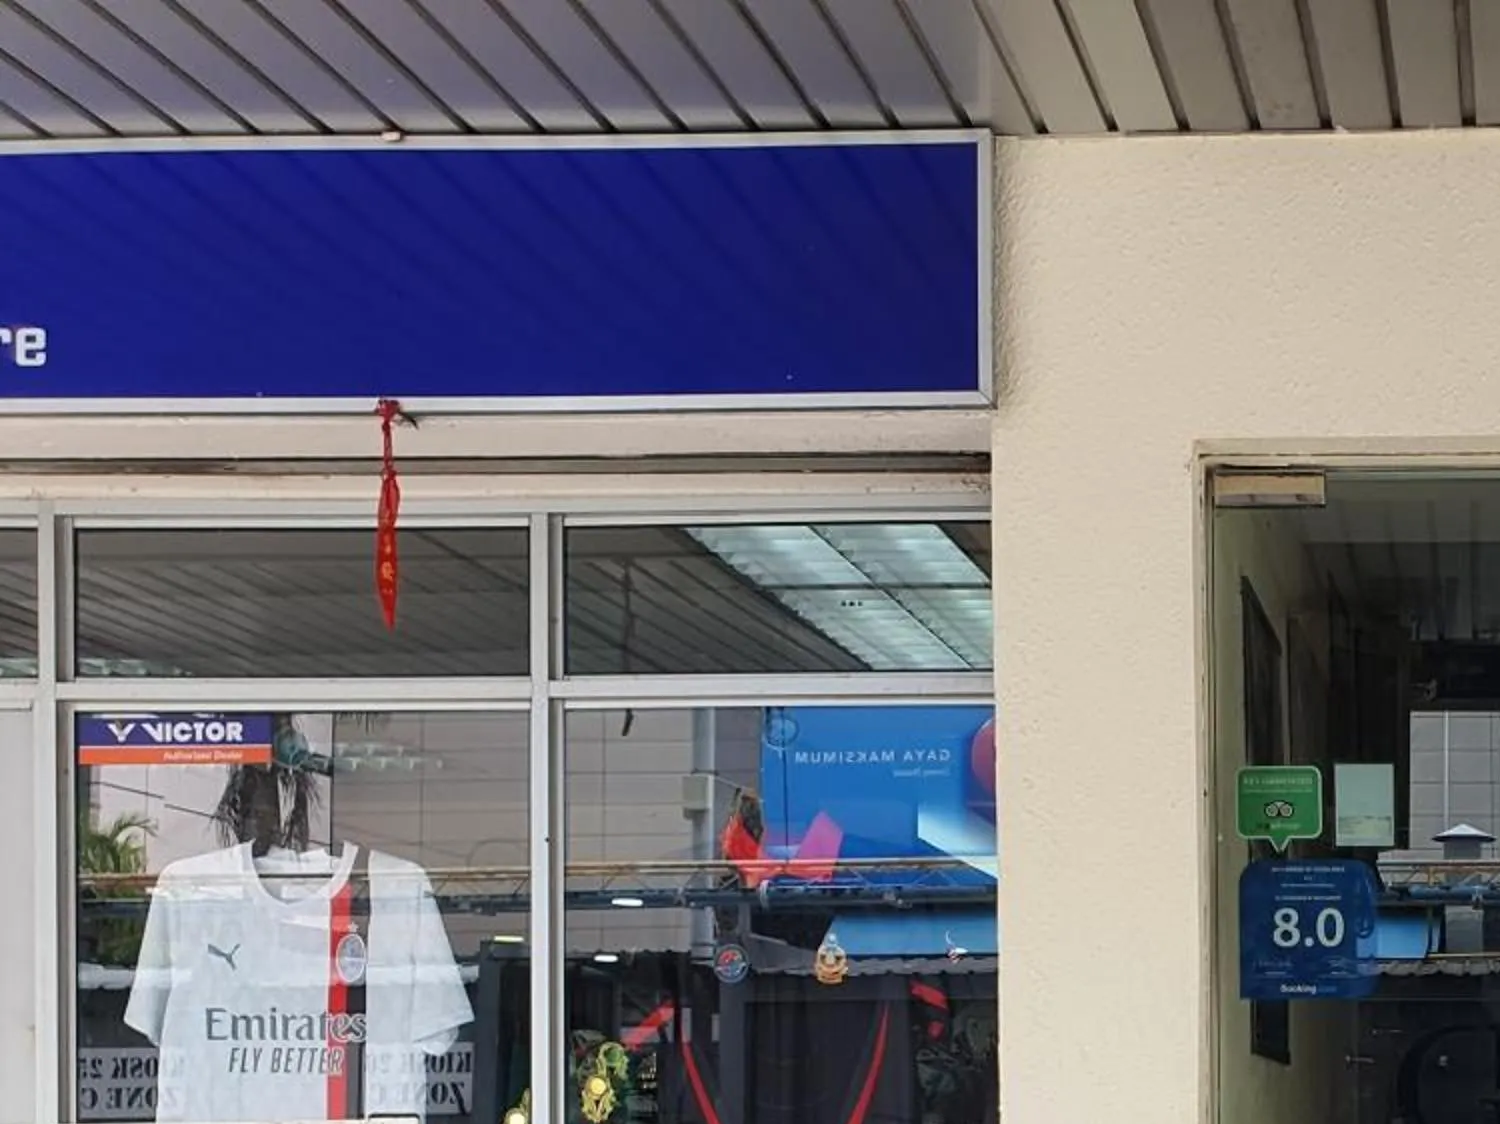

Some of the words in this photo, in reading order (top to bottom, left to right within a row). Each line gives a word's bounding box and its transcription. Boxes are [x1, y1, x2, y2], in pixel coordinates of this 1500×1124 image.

[141, 721, 243, 743] VICTOR
[1273, 907, 1345, 947] 8.0
[205, 1006, 367, 1042] Emirates
[228, 1047, 263, 1074] FLY
[270, 1047, 347, 1076] BETTER
